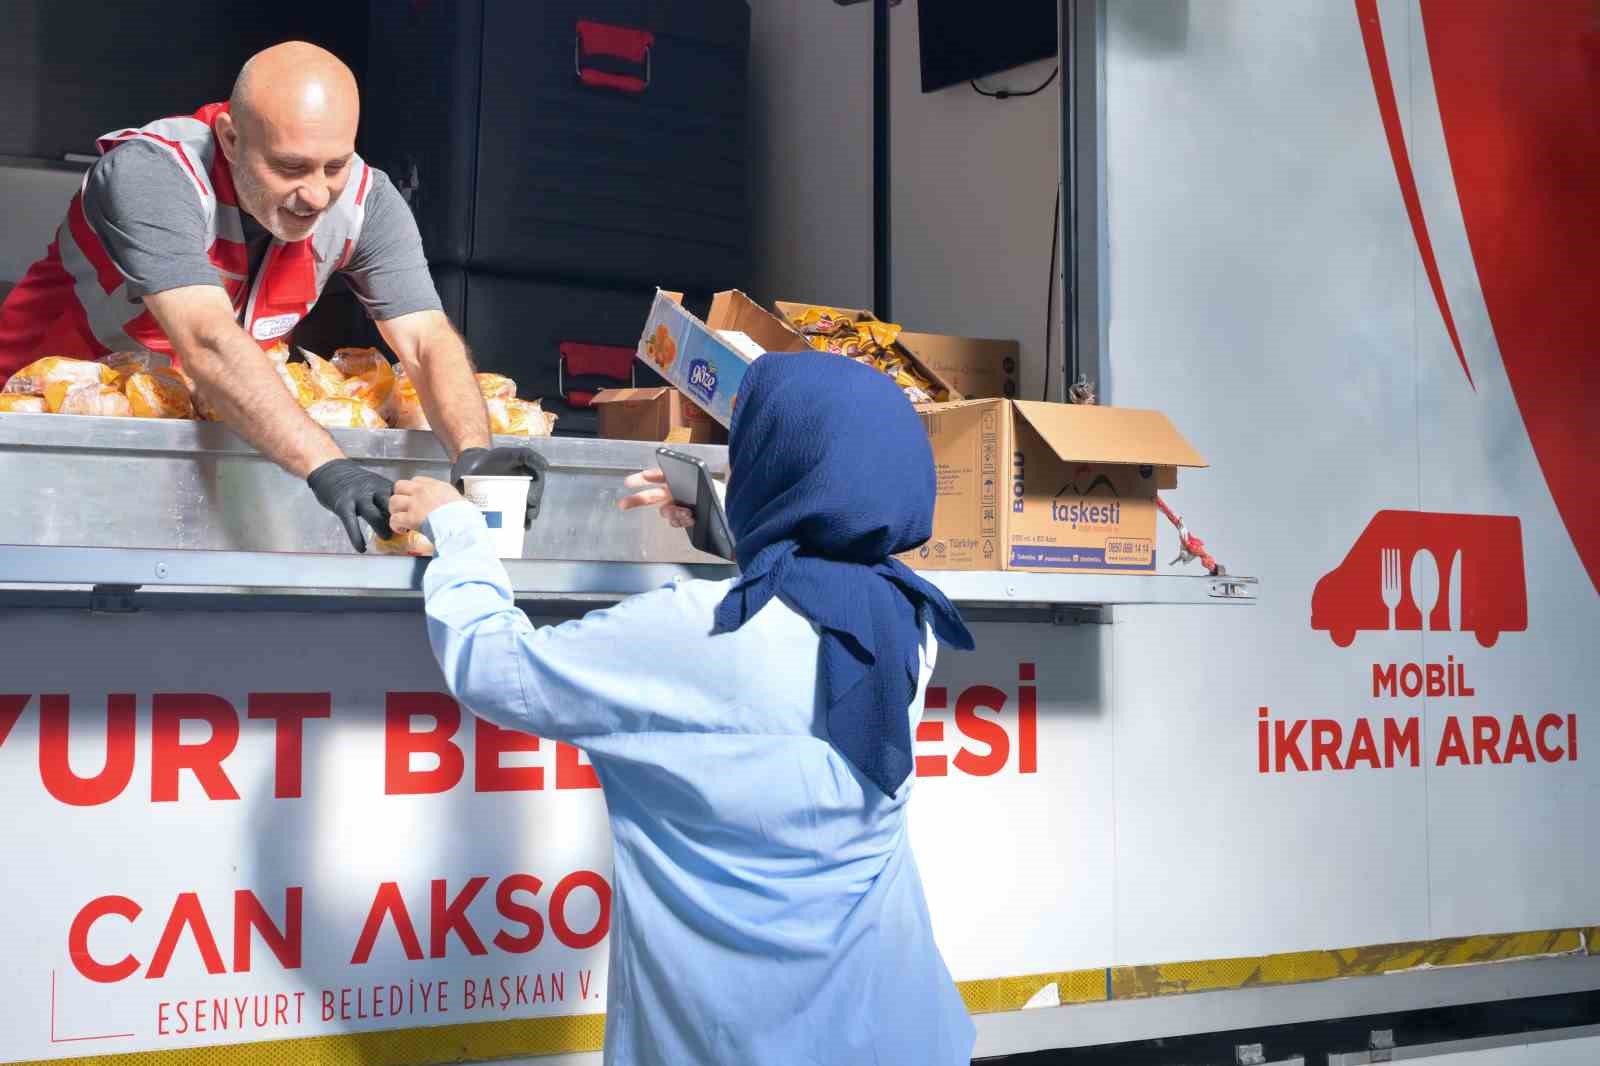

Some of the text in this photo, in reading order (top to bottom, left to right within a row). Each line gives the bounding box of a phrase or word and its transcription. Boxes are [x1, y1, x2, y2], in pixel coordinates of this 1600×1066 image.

[1052, 500, 1120, 529] taşkesti
[1371, 655, 1475, 698] MOBİL
[1257, 706, 1578, 774] İKRAM ARACI
[67, 886, 304, 984] CAN
[158, 992, 306, 1036] ESENYURT
[321, 978, 449, 1022] BELEDİYE
[464, 972, 565, 1012] BAŞKAN
